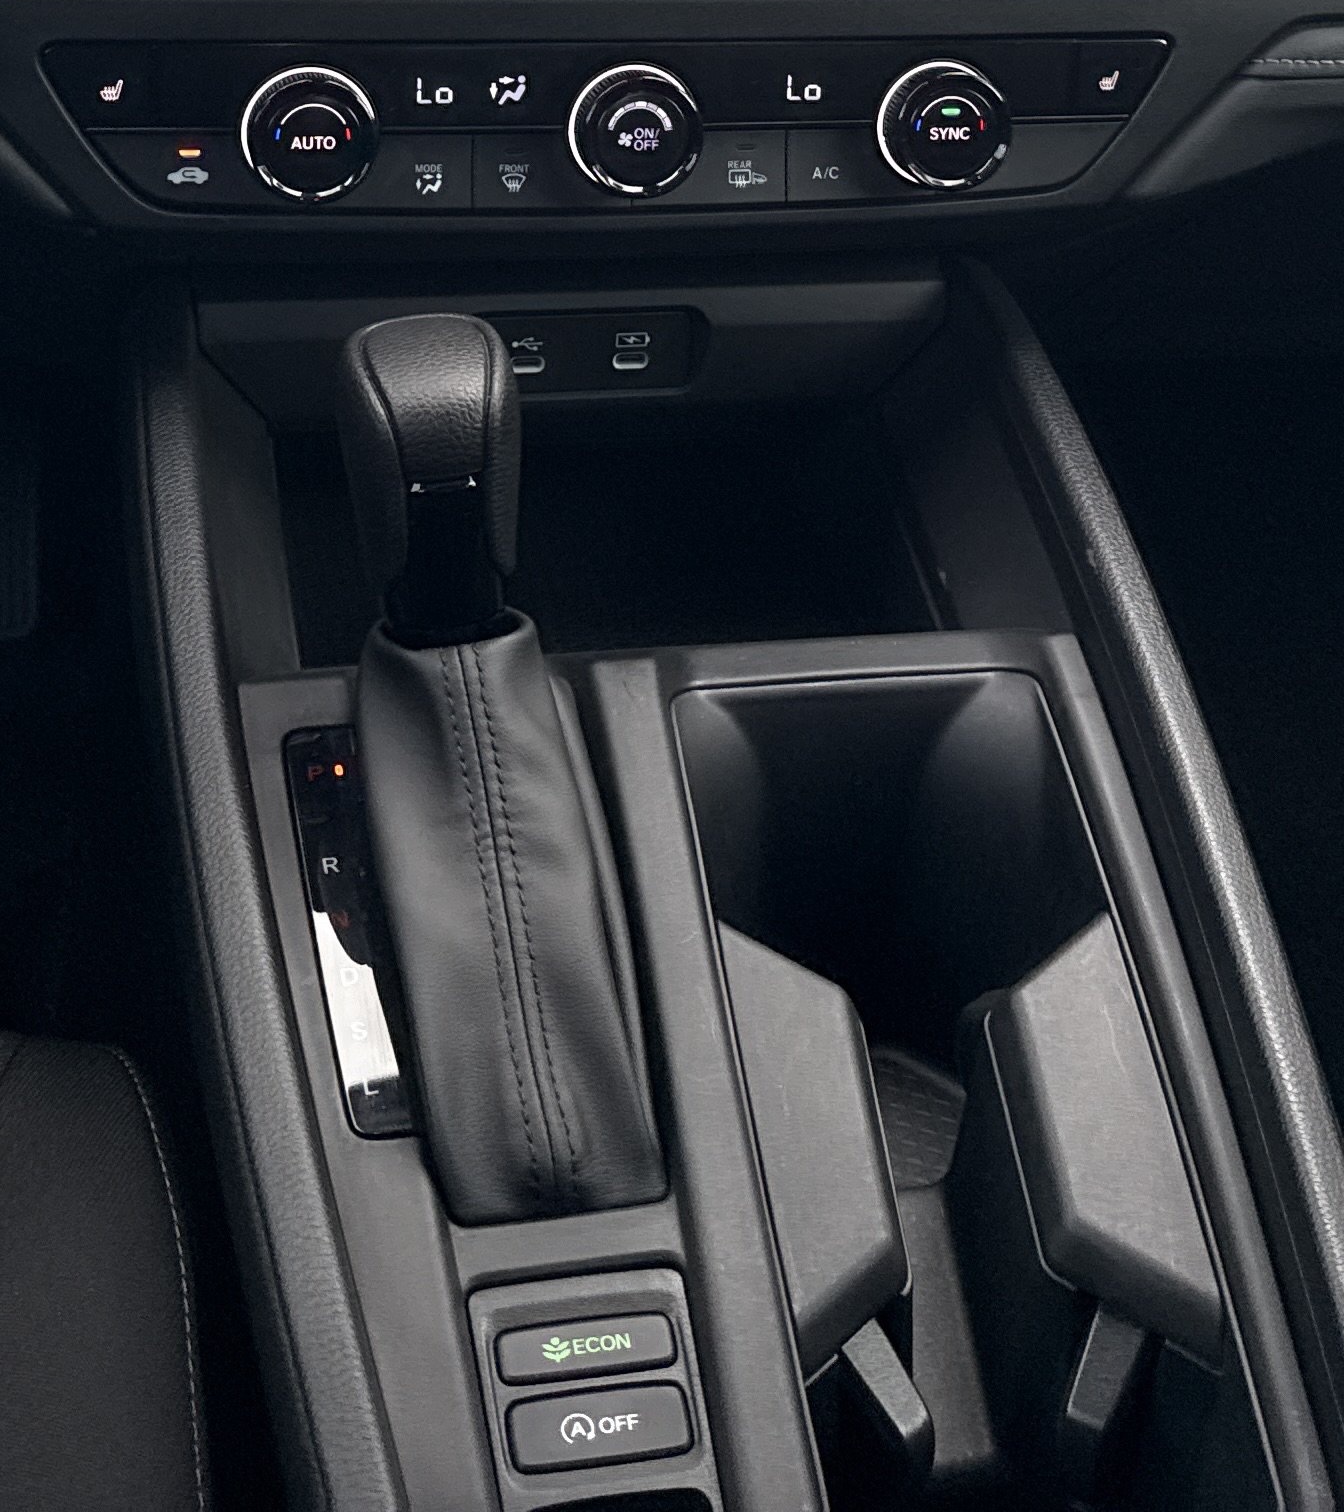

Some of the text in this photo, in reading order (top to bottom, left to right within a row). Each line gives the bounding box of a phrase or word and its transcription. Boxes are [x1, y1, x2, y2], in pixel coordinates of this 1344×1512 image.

[416, 77, 453, 105] Lo
[787, 74, 822, 102] Lo
[633, 127, 661, 139] ON/
[929, 126, 971, 141] SYNC
[290, 135, 336, 151] AUTO
[633, 139, 660, 152] OFF
[415, 163, 443, 173] MODE
[498, 163, 529, 174] FRONT
[727, 160, 752, 169] REAR
[812, 166, 840, 181] A/C
[307, 764, 325, 782] P
[321, 857, 340, 875] R
[340, 967, 358, 986] D
[350, 1021, 368, 1040] S
[363, 1077, 379, 1095] L
[572, 1333, 632, 1355] ECON
[598, 1413, 639, 1434] OFF
